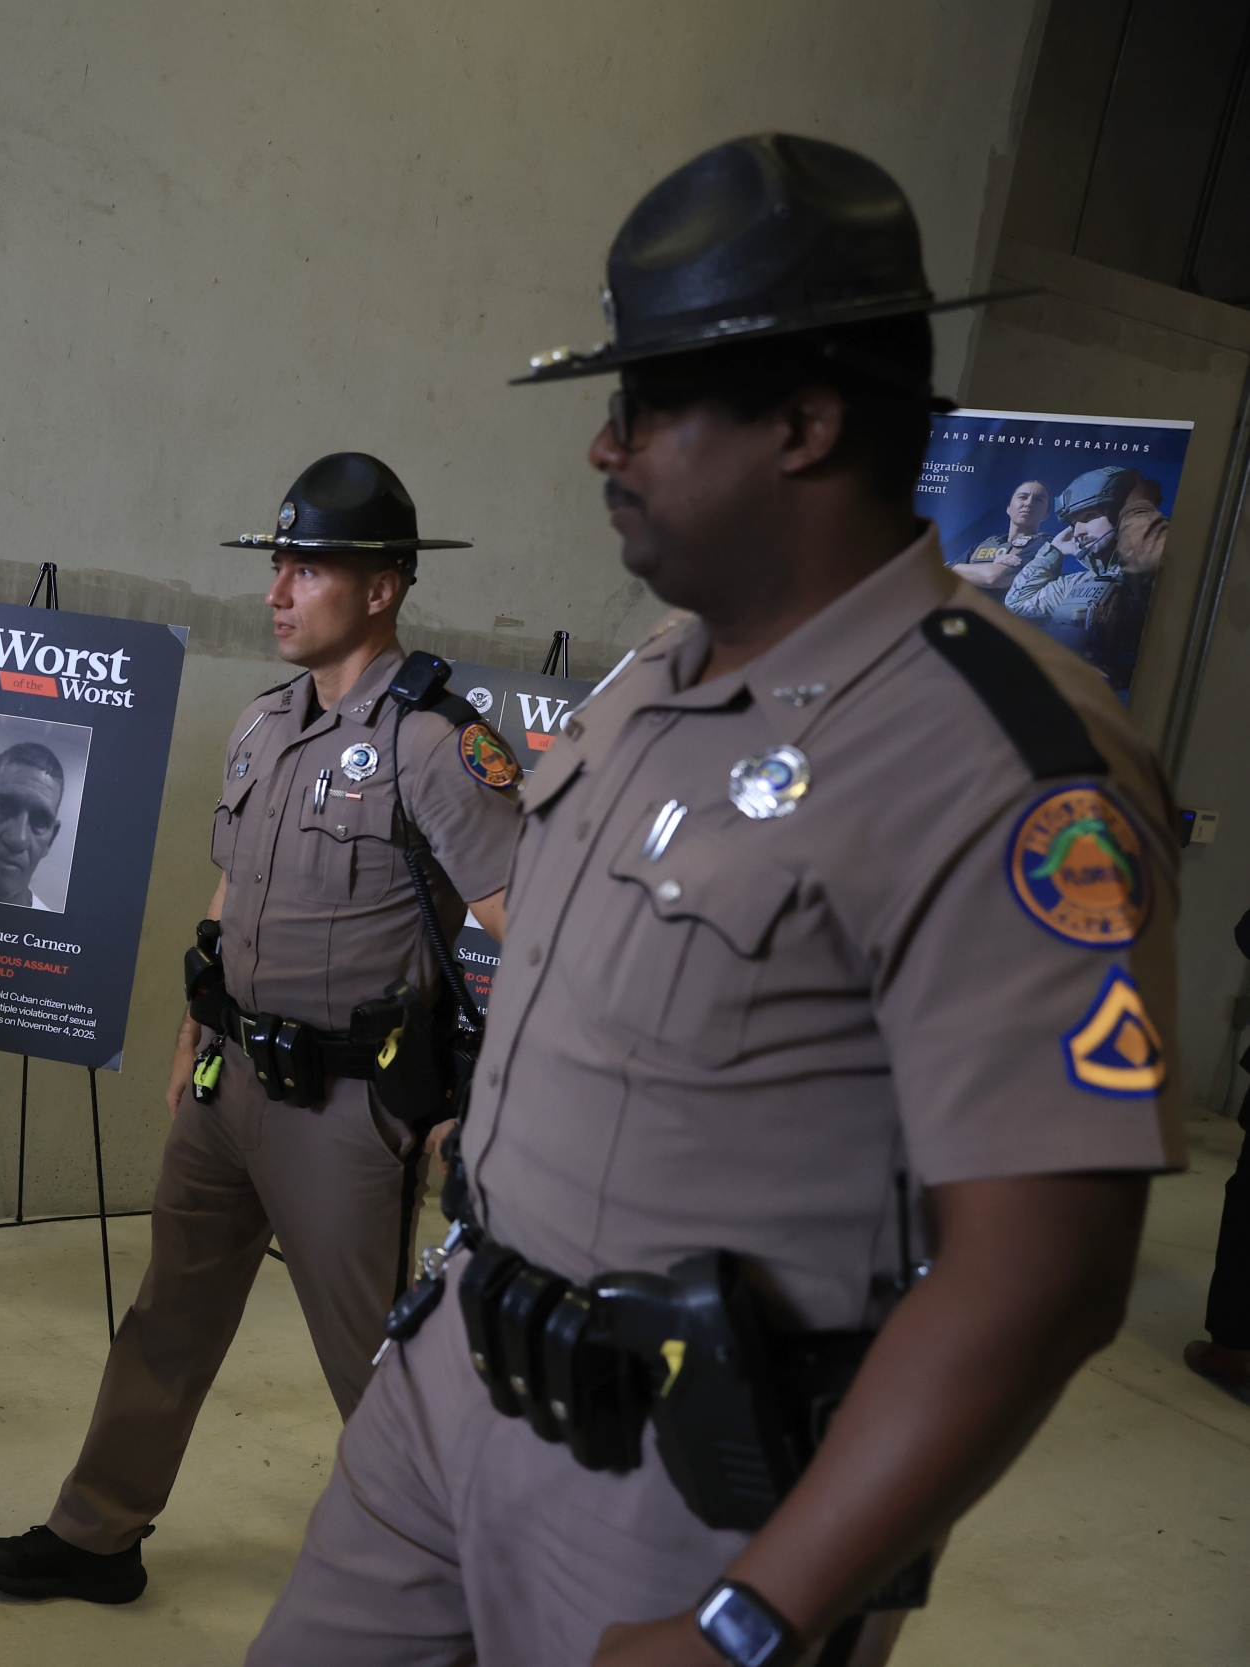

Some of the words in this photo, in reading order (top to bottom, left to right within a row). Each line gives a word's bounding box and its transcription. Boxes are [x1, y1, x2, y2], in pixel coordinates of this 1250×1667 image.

[943, 431, 969, 441] AND
[978, 433, 1044, 446] REMOVAL
[1053, 438, 1150, 453] OPERATIONS
[919, 472, 950, 483] toms
[976, 547, 1008, 559] ERO
[1069, 586, 1104, 599] POLICE
[12, 678, 25, 690] of
[26, 679, 43, 692] the
[59, 676, 135, 709] Worst
[23, 933, 81, 954] Carnero
[23, 959, 69, 975] ASSAULT
[458, 947, 502, 967] Saturn
[476, 974, 489, 984] OR
[10, 992, 39, 1005] Cuban
[39, 997, 67, 1010] citizen
[67, 1003, 86, 1014] with
[86, 1007, 93, 1015] a
[18, 1007, 58, 1021] violations
[58, 1013, 69, 1022] of
[69, 1016, 97, 1028] sexual
[4, 1016, 16, 1026] on
[16, 1018, 63, 1034] November
[62, 1026, 71, 1037] 4,
[71, 1028, 97, 1040] 2025.
